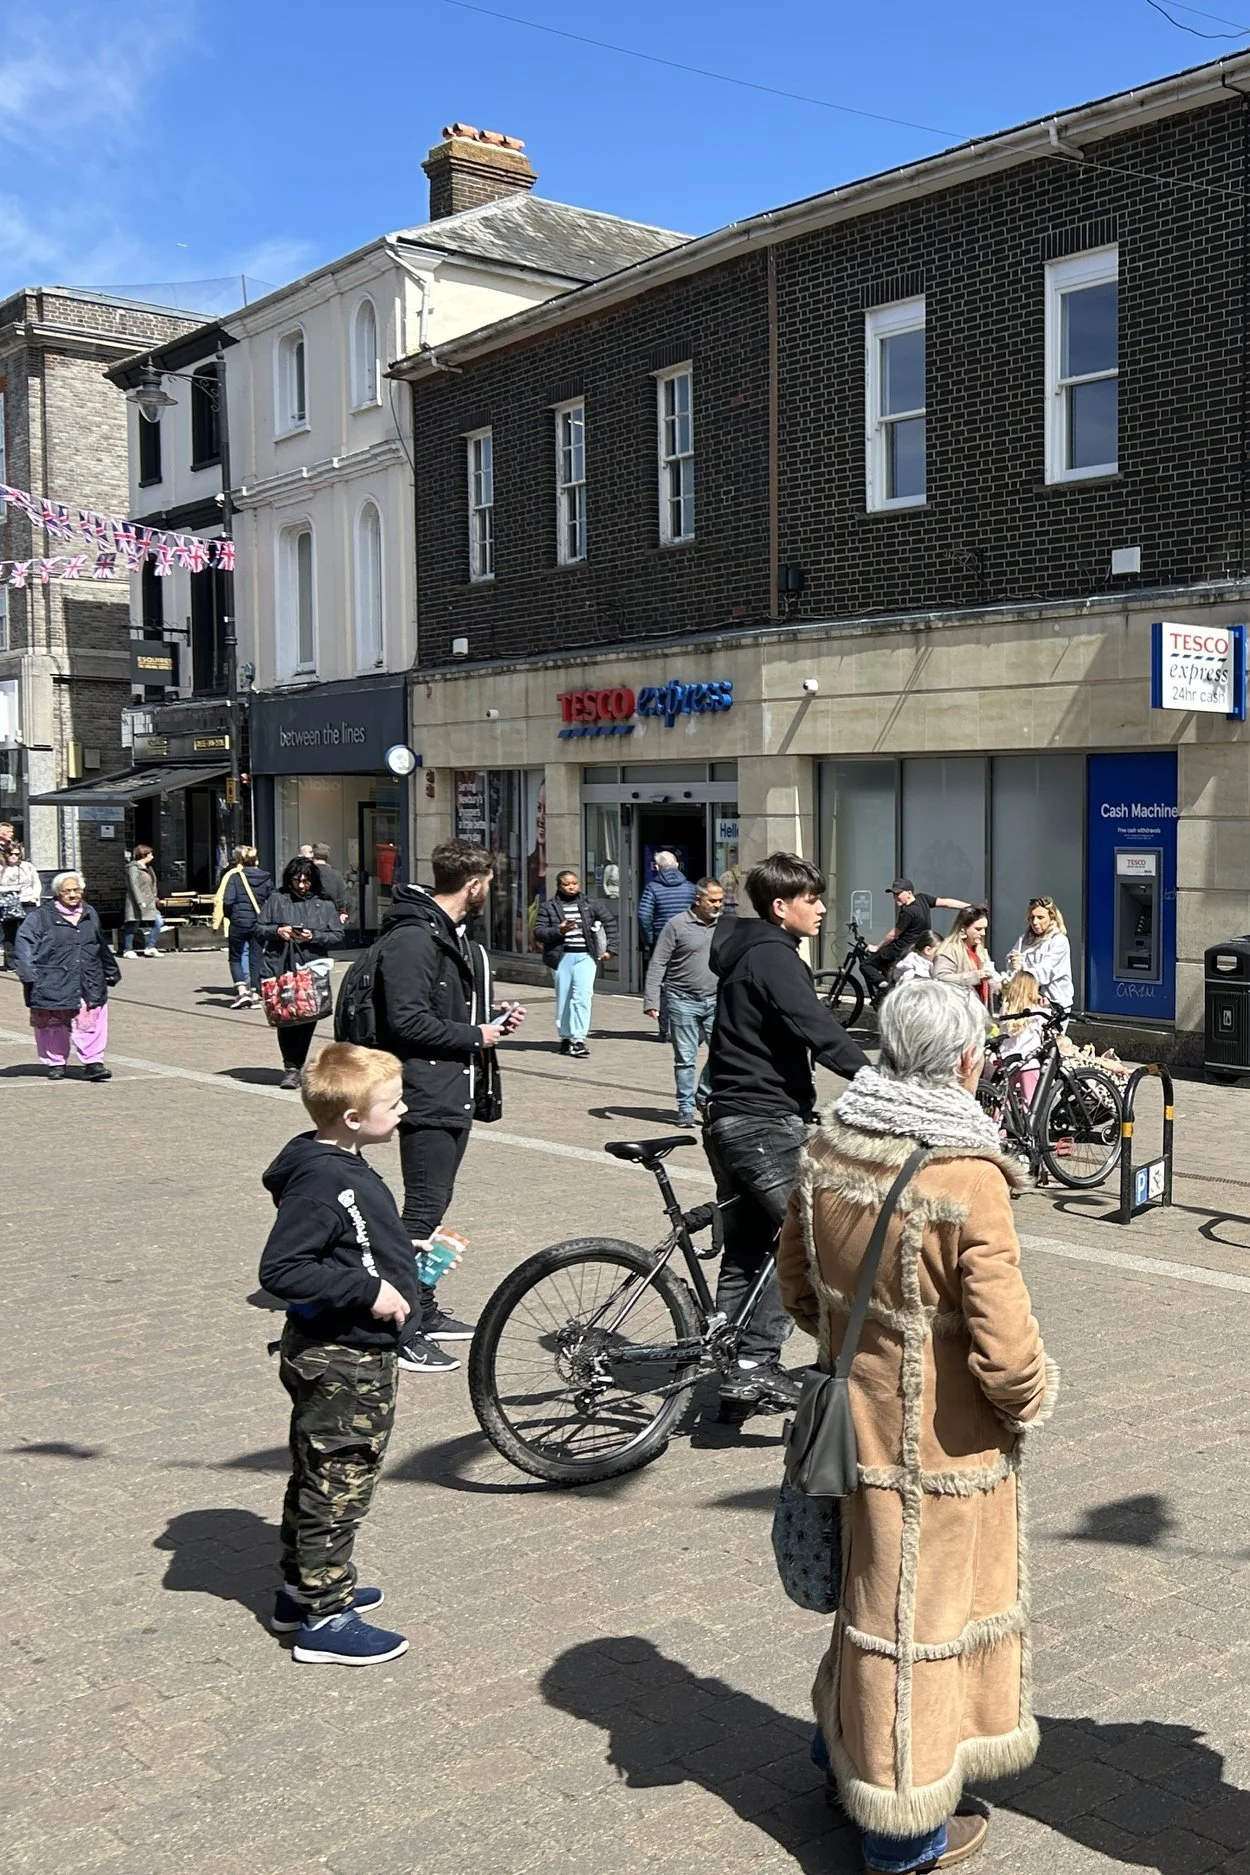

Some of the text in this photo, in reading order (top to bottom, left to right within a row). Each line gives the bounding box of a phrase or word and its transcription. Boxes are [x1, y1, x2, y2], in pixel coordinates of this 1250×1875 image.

[1170, 633, 1229, 654] TESCO
[1170, 664, 1229, 685] express
[557, 680, 733, 728] TESCO express
[1172, 686, 1226, 704] 24hr cash
[280, 720, 366, 747] between the lines
[1101, 803, 1179, 818] Cash Machine
[1138, 1172, 1146, 1202] P
